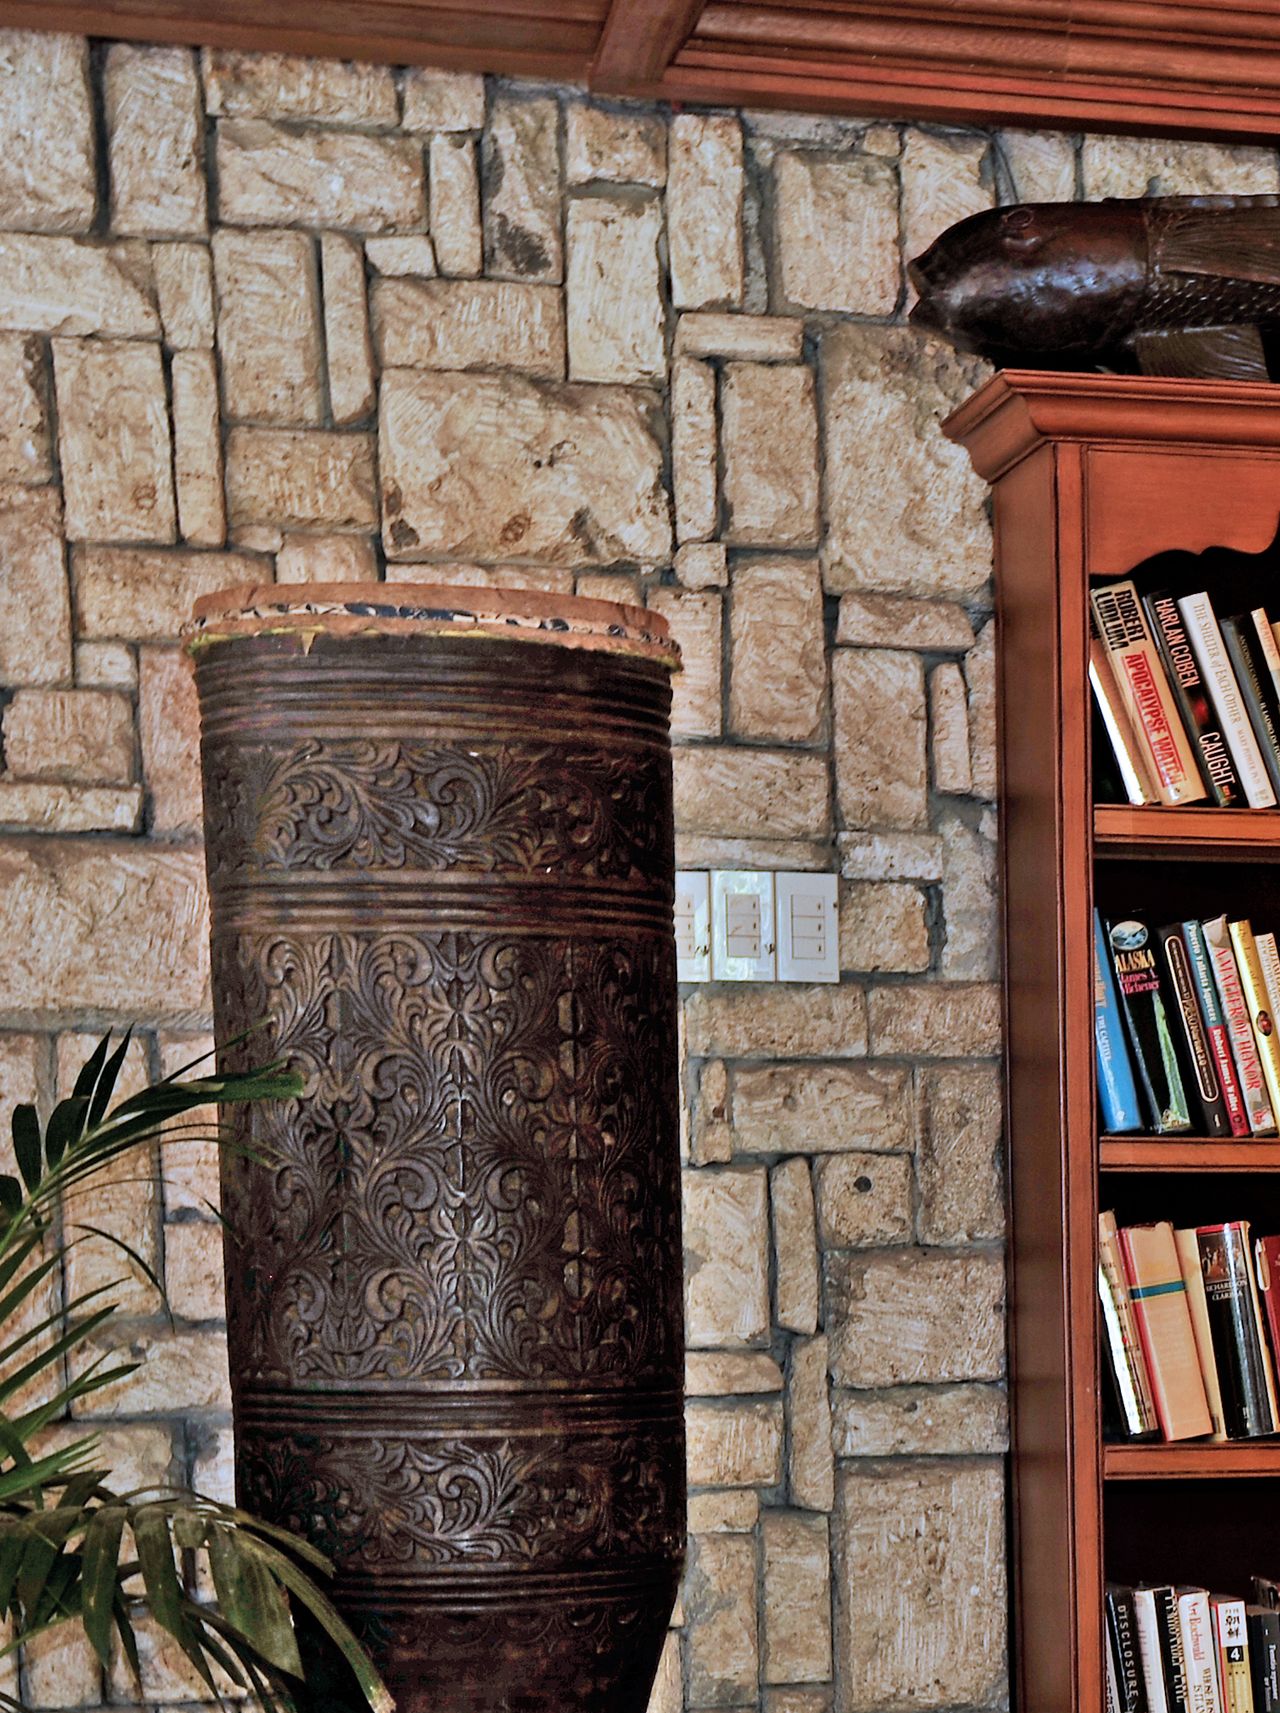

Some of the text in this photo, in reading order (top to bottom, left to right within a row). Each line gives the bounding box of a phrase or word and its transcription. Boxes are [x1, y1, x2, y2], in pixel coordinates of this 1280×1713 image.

[1090, 589, 1132, 652] LUDLUM
[1110, 586, 1150, 646] ROBERT
[1191, 601, 1209, 621] THE
[1151, 596, 1201, 689] HARLAN COBEN
[1197, 621, 1223, 659] SHELTER
[1213, 667, 1234, 693] EACH
[1221, 691, 1245, 725] OTHER
[1119, 650, 1185, 786] APOCALYPSE WATCH
[1195, 729, 1237, 789] CAUGHT
[1115, 949, 1156, 973] ALASKA
[1186, 923, 1220, 1023] Puerto Vallarta Squeeze
[1211, 954, 1249, 1020] MATTER
[1230, 1017, 1252, 1040] OF
[1210, 1027, 1241, 1113] Robert James Waller
[1232, 1038, 1265, 1093] HONOR
[1115, 1604, 1139, 1698] DISCLOSURE
[1187, 1616, 1206, 1661] Buchwald
[1230, 1647, 1240, 1661] 4
[1201, 1666, 1214, 1696] WHOSE
[1266, 1643, 1279, 1700] Femtio nyanser
